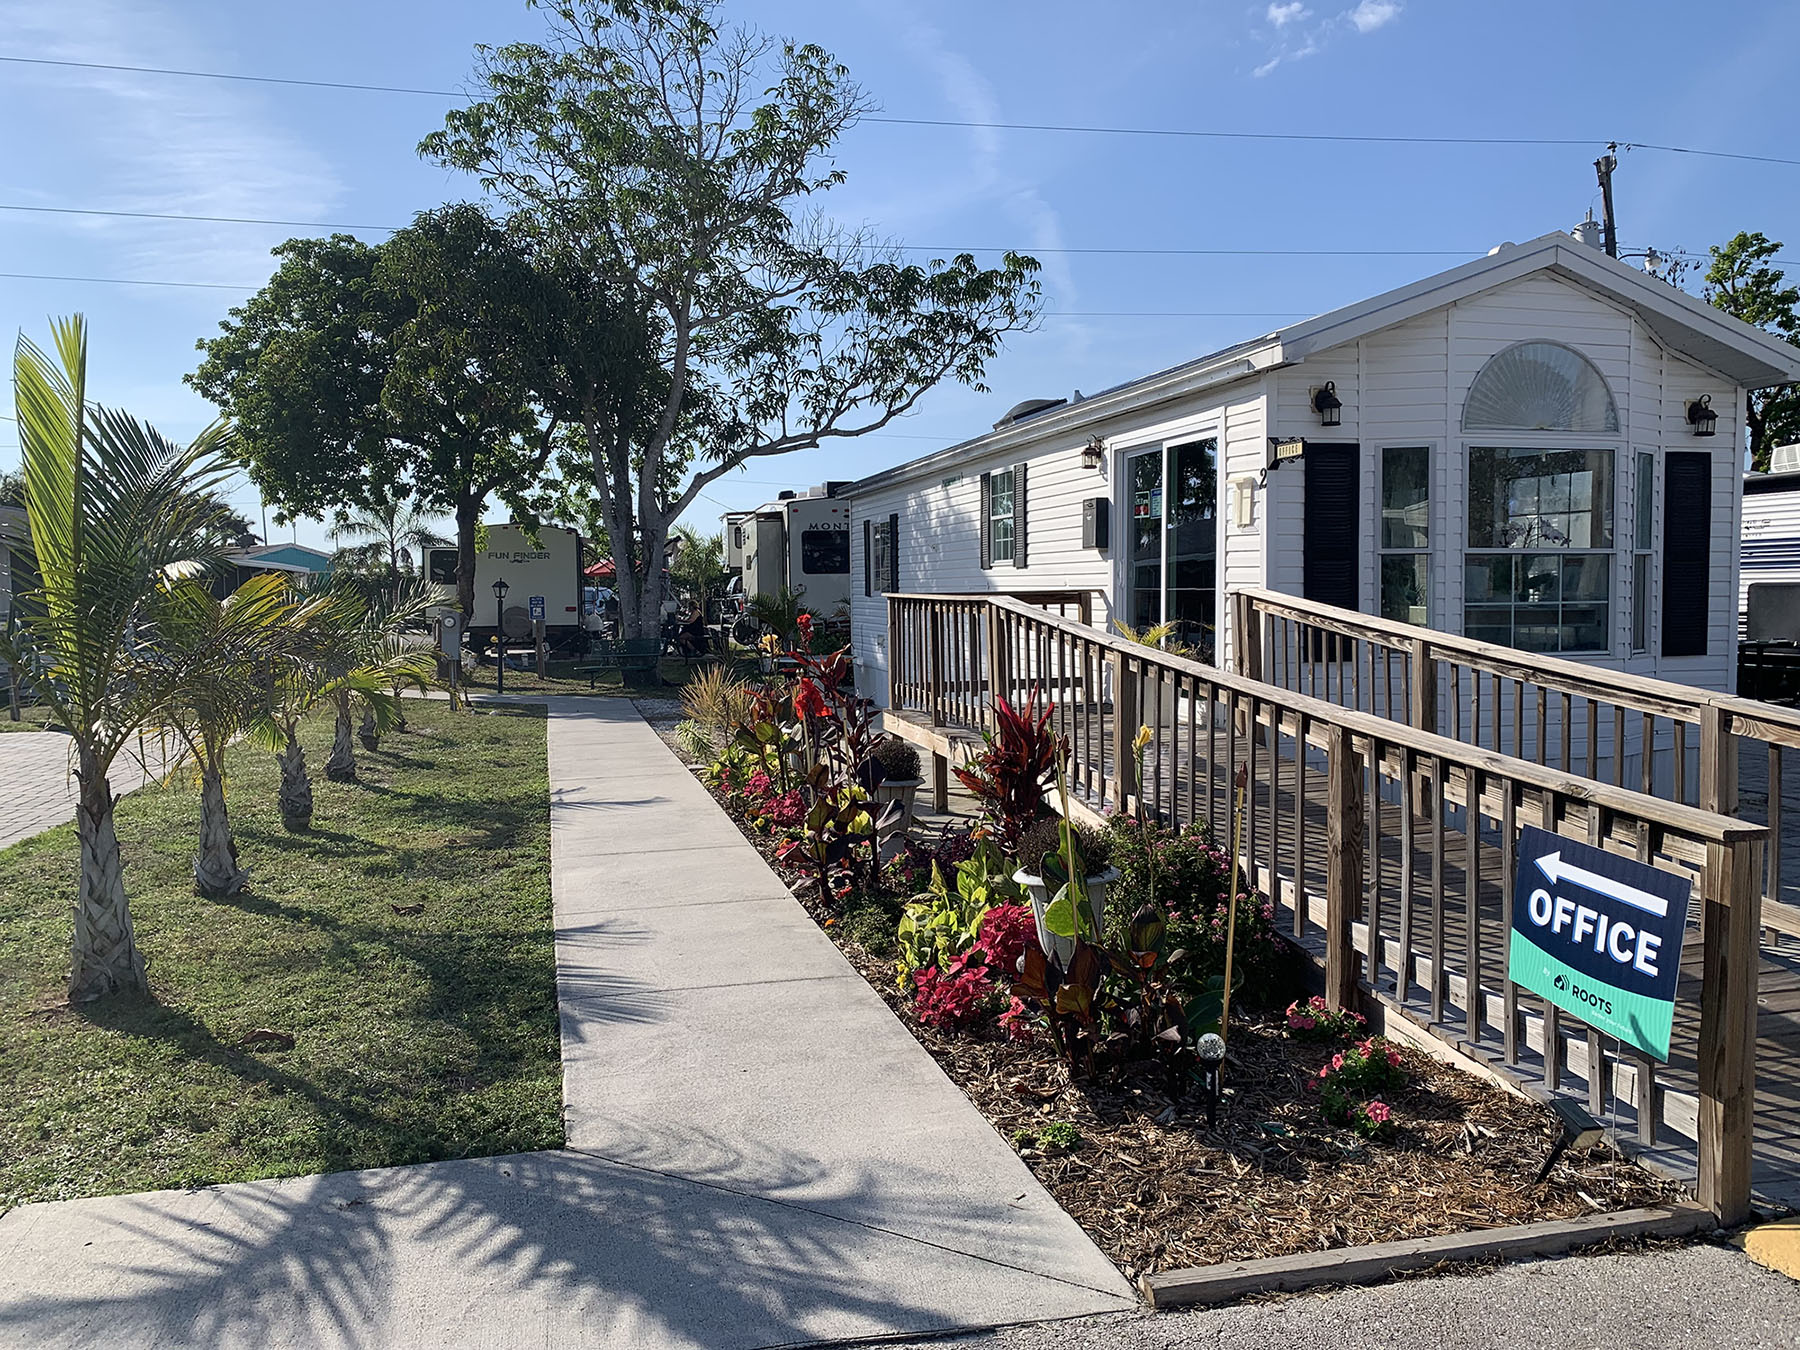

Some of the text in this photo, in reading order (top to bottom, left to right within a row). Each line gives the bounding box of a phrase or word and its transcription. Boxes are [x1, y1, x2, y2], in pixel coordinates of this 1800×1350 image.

[1279, 444, 1298, 457] OFFICE
[1259, 468, 1267, 489] 2
[1527, 888, 1663, 978] OFFICE
[1572, 984, 1613, 1015] ROOTS
